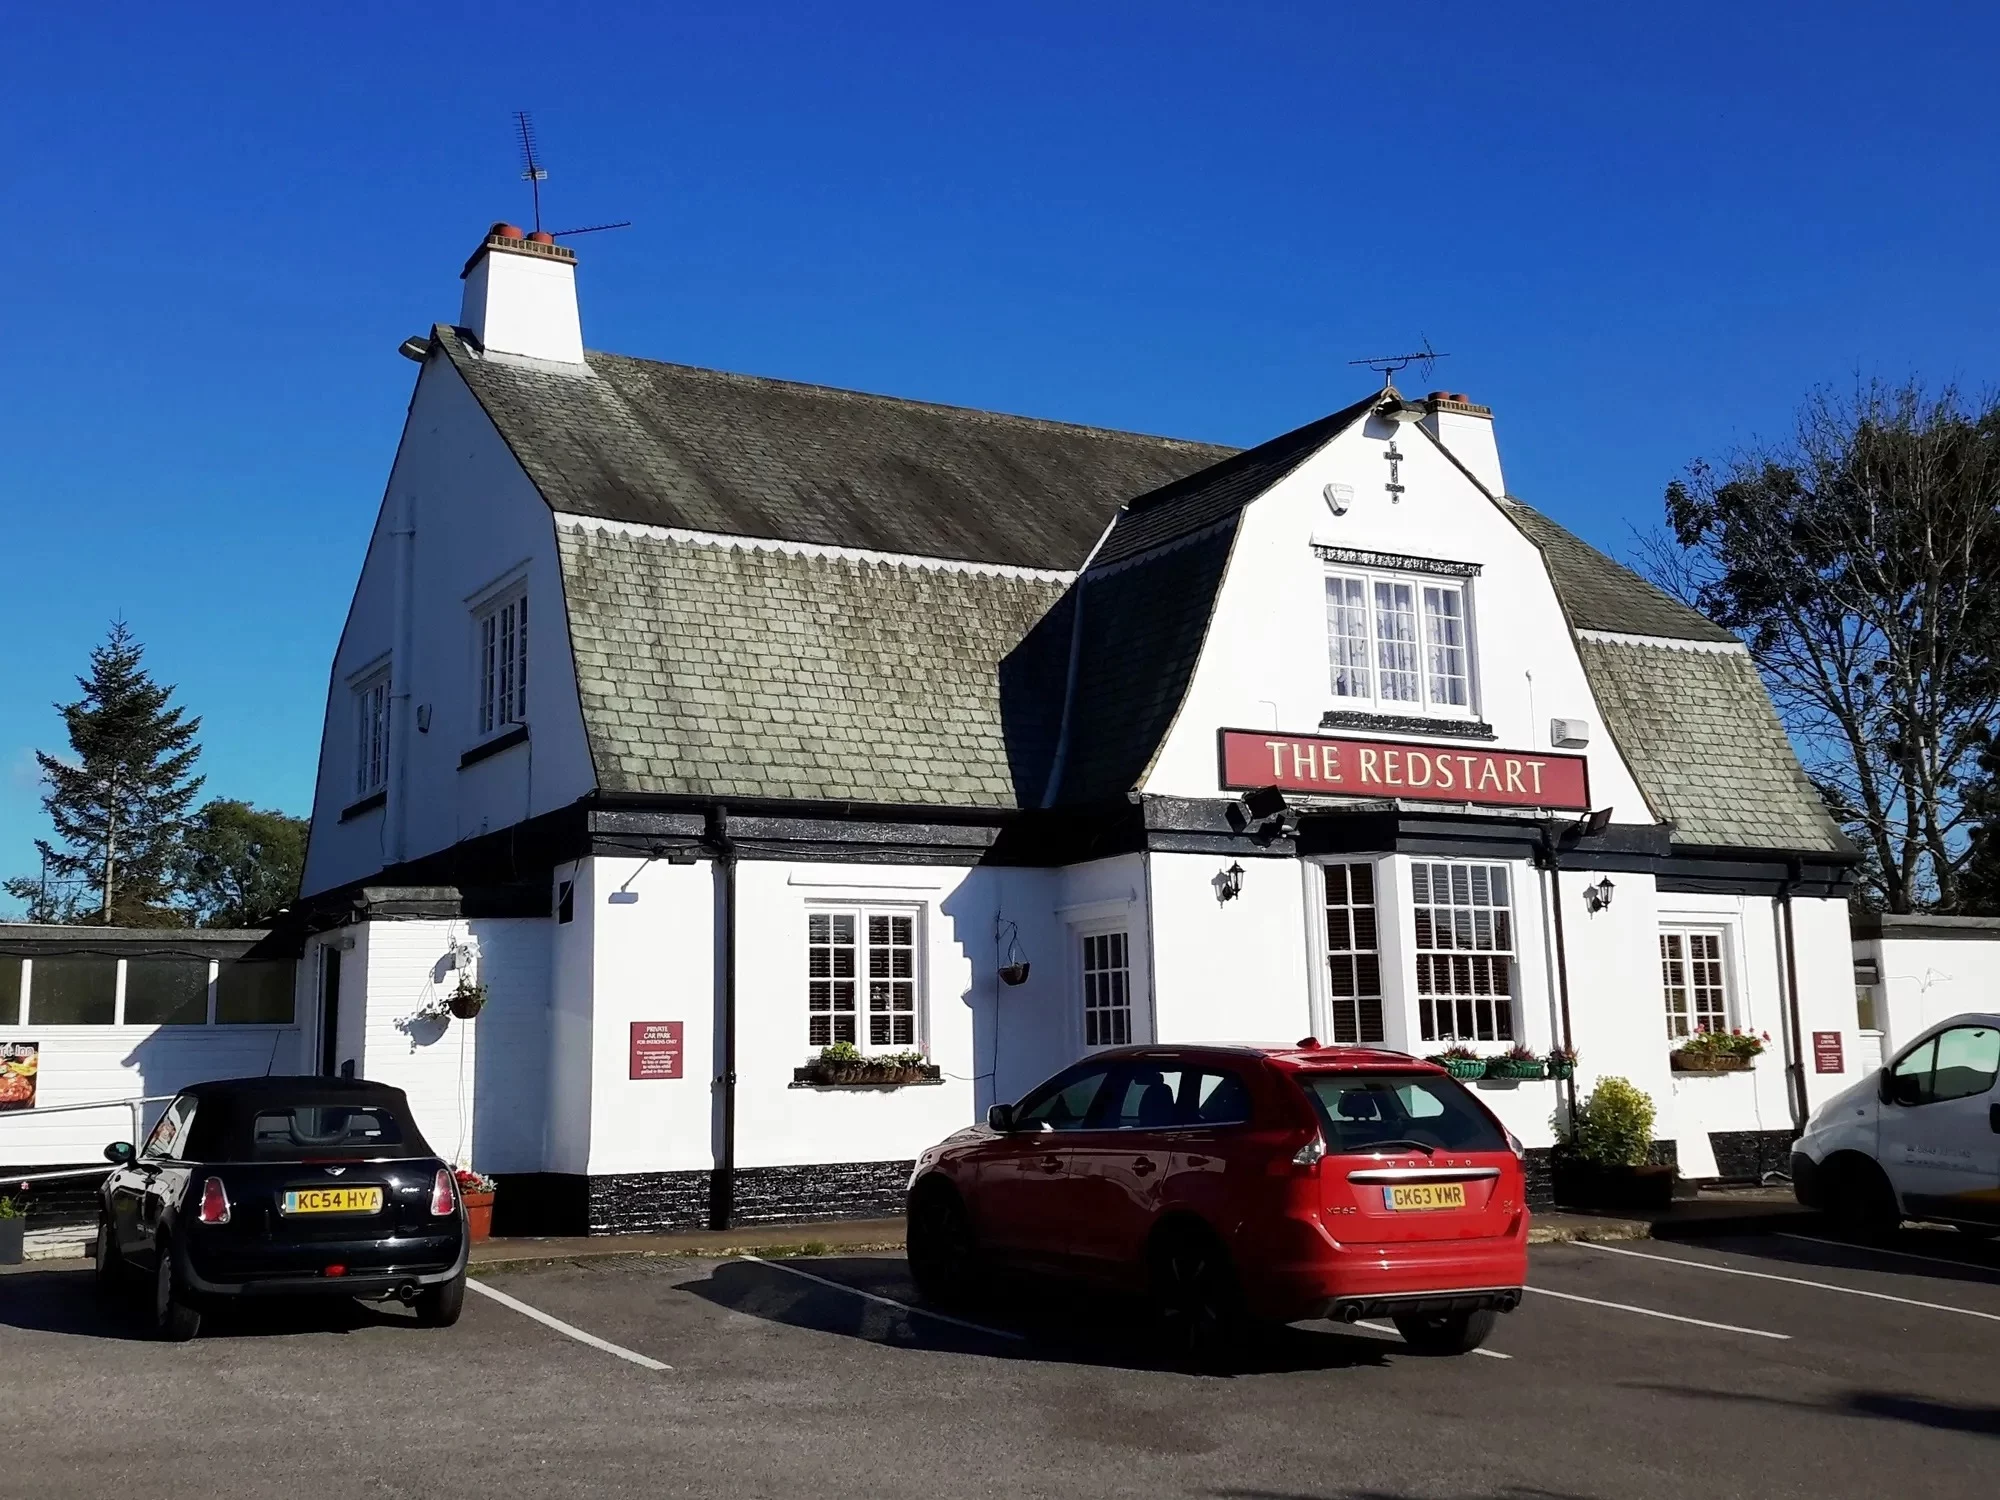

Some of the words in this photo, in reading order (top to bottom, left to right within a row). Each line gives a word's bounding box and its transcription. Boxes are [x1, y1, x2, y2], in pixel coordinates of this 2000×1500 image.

[1265, 742, 1342, 783] THE
[1359, 748, 1546, 794] REDSTART
[15, 1044, 34, 1057] Inn
[1387, 1159, 1472, 1167] VOLVO
[298, 1193, 342, 1209] KC54
[347, 1192, 379, 1207] HYA
[1394, 1188, 1432, 1206] GK63
[1436, 1186, 1462, 1204] VMR
